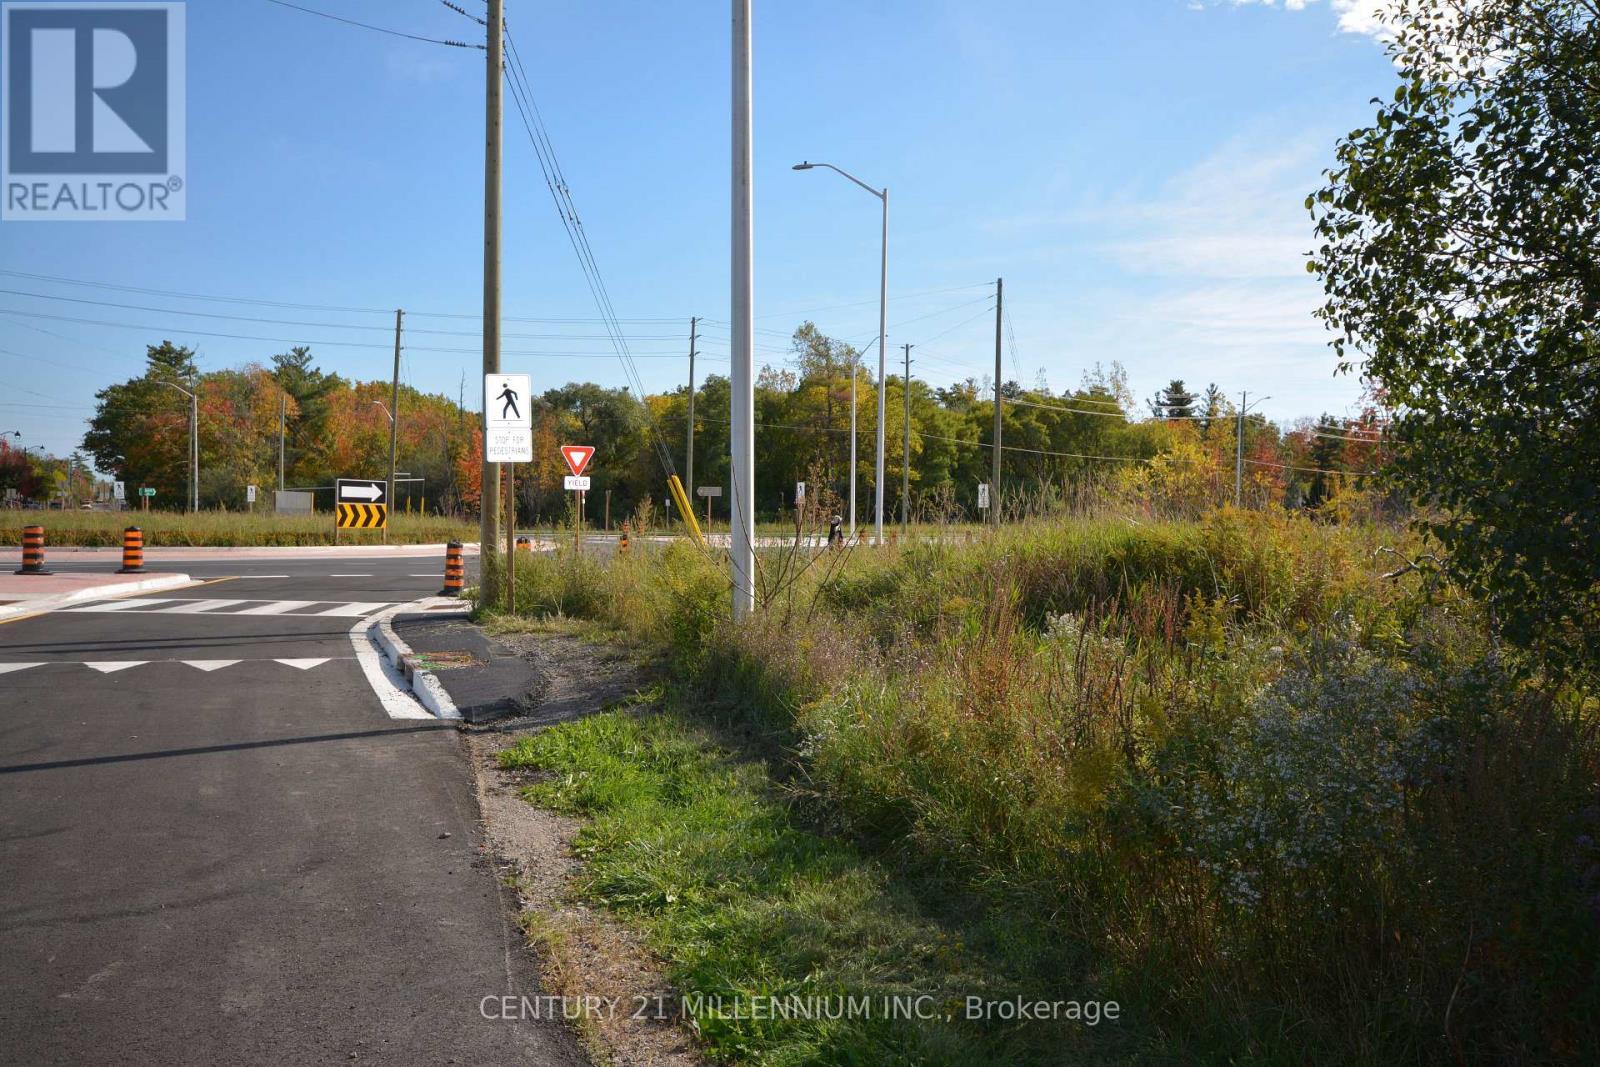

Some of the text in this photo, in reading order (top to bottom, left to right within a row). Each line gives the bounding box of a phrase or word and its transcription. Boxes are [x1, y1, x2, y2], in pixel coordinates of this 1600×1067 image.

[495, 435, 525, 445] STOP FOR
[489, 446, 530, 456] PEDESTRIANS
[567, 479, 588, 487] YIELD
